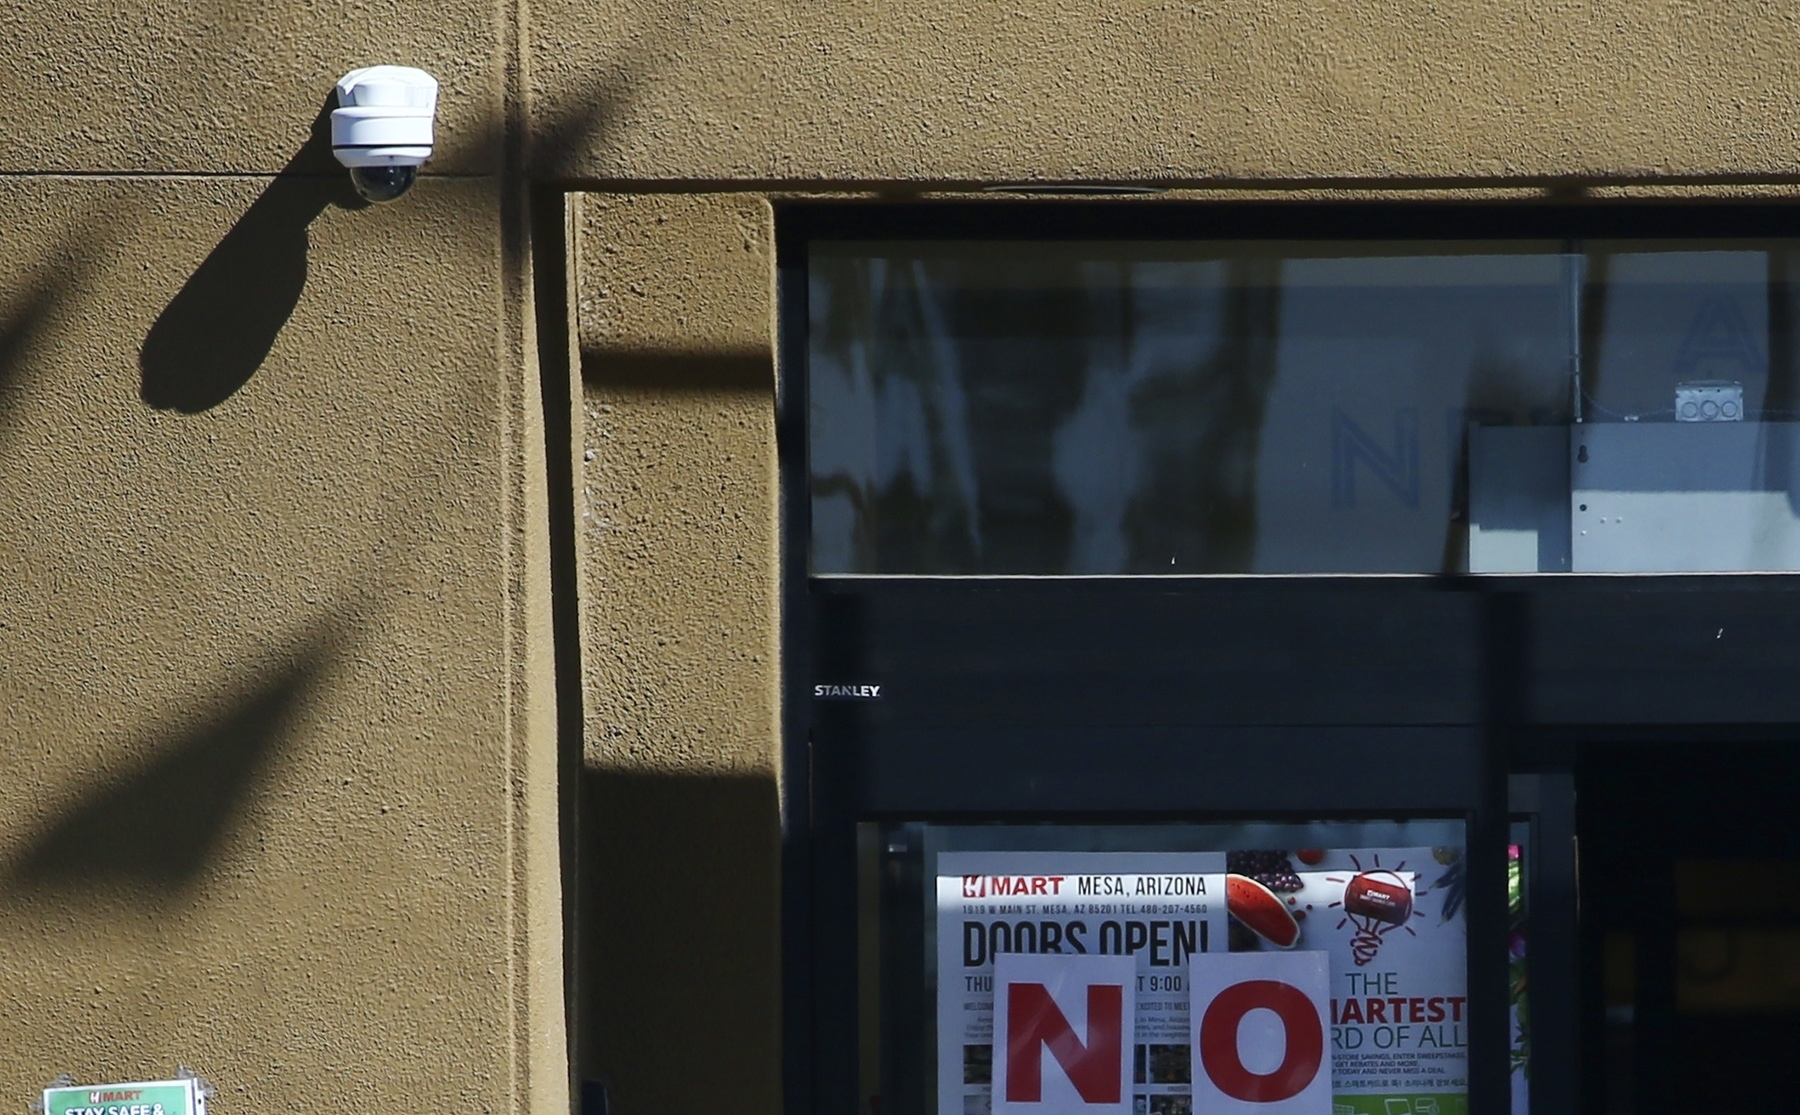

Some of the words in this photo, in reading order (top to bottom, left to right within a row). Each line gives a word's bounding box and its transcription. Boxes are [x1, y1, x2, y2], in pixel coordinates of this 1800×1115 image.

[815, 685, 880, 697] STANLEY
[992, 877, 1063, 896] MART
[1078, 877, 1130, 898] MESA,
[1136, 877, 1207, 895] ARIZONA
[1000, 905, 1022, 914] MAIN
[1073, 905, 1085, 914] AZ
[964, 921, 1087, 967] DOORS
[1100, 920, 1208, 967] OPEN!
[1150, 976, 1182, 992] 9:00
[1345, 972, 1398, 995] THE
[1331, 997, 1467, 1024] ARTEST
[1005, 979, 1325, 1104] NO
[1331, 1026, 1363, 1050] RD
[1373, 1026, 1411, 1049] OF
[1418, 1025, 1468, 1049] ALL
[103, 1090, 143, 1102] MART
